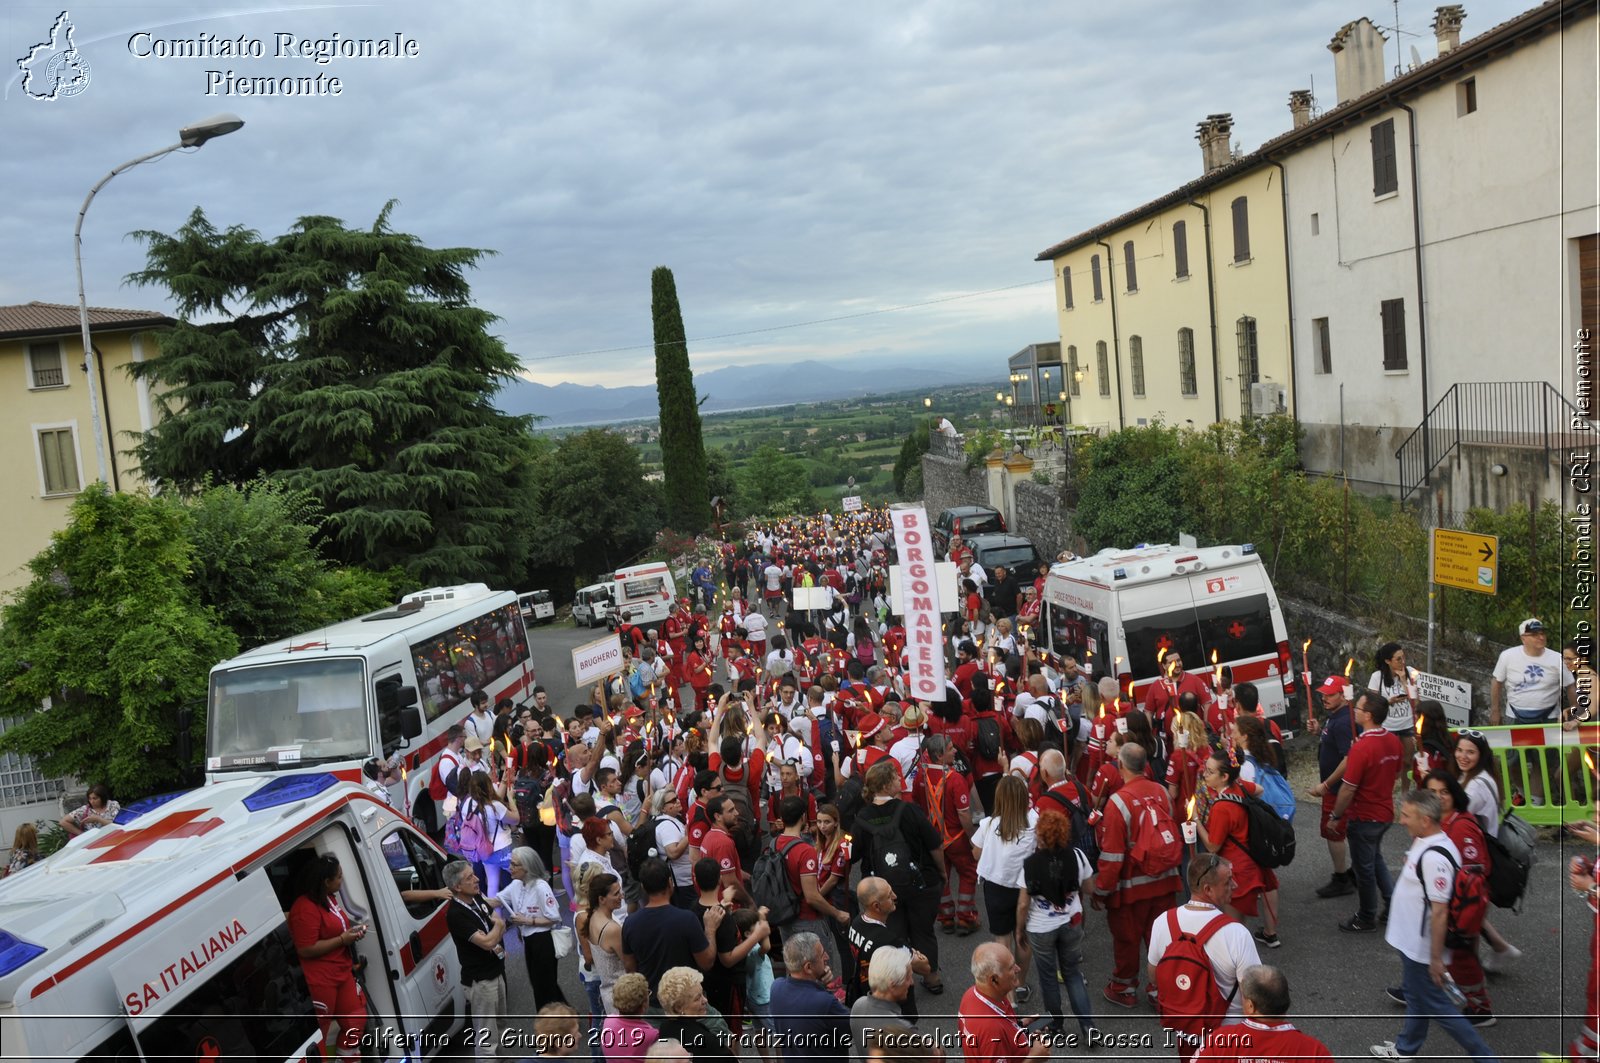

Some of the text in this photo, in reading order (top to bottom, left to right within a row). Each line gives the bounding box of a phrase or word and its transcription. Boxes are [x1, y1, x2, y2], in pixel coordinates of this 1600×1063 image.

[902, 514, 936, 694] BORGOMANERO
[580, 649, 618, 670] BRUGHERIO
[1421, 682, 1442, 692] CORTE
[1423, 689, 1450, 702] BARCHE
[159, 920, 248, 993] ITALIANA
